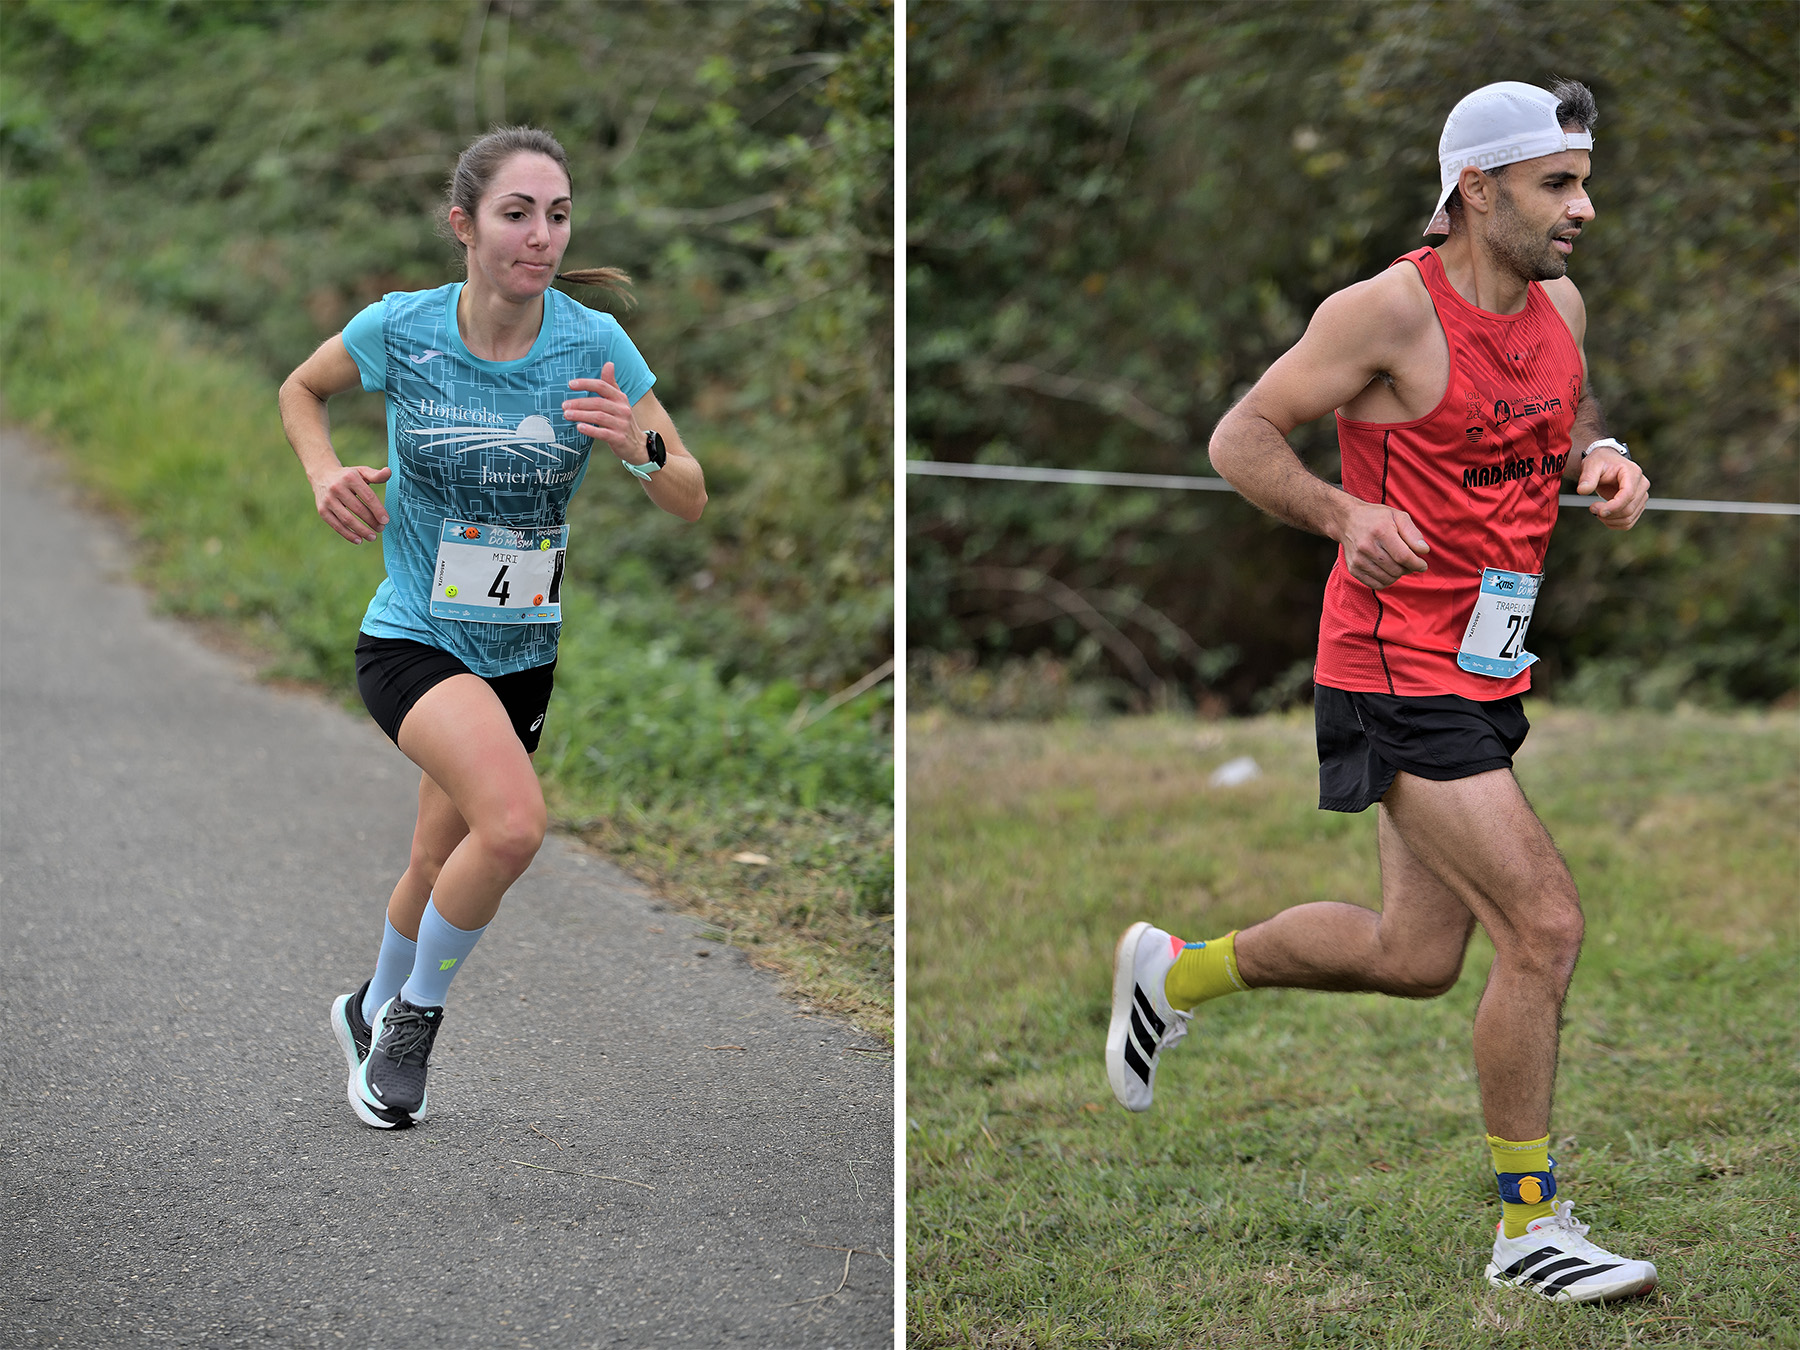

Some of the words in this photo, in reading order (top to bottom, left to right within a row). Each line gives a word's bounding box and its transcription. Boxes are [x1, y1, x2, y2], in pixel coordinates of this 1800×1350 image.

[420, 398, 504, 424] Hortícolas
[1512, 398, 1562, 418] LEMA
[478, 465, 529, 485] Javier
[1462, 457, 1535, 489] MADERAS
[488, 536, 504, 545] DO
[490, 528, 505, 537] AO
[506, 529, 526, 540] SON
[492, 552, 518, 564] MIRI
[487, 564, 511, 606] 4
